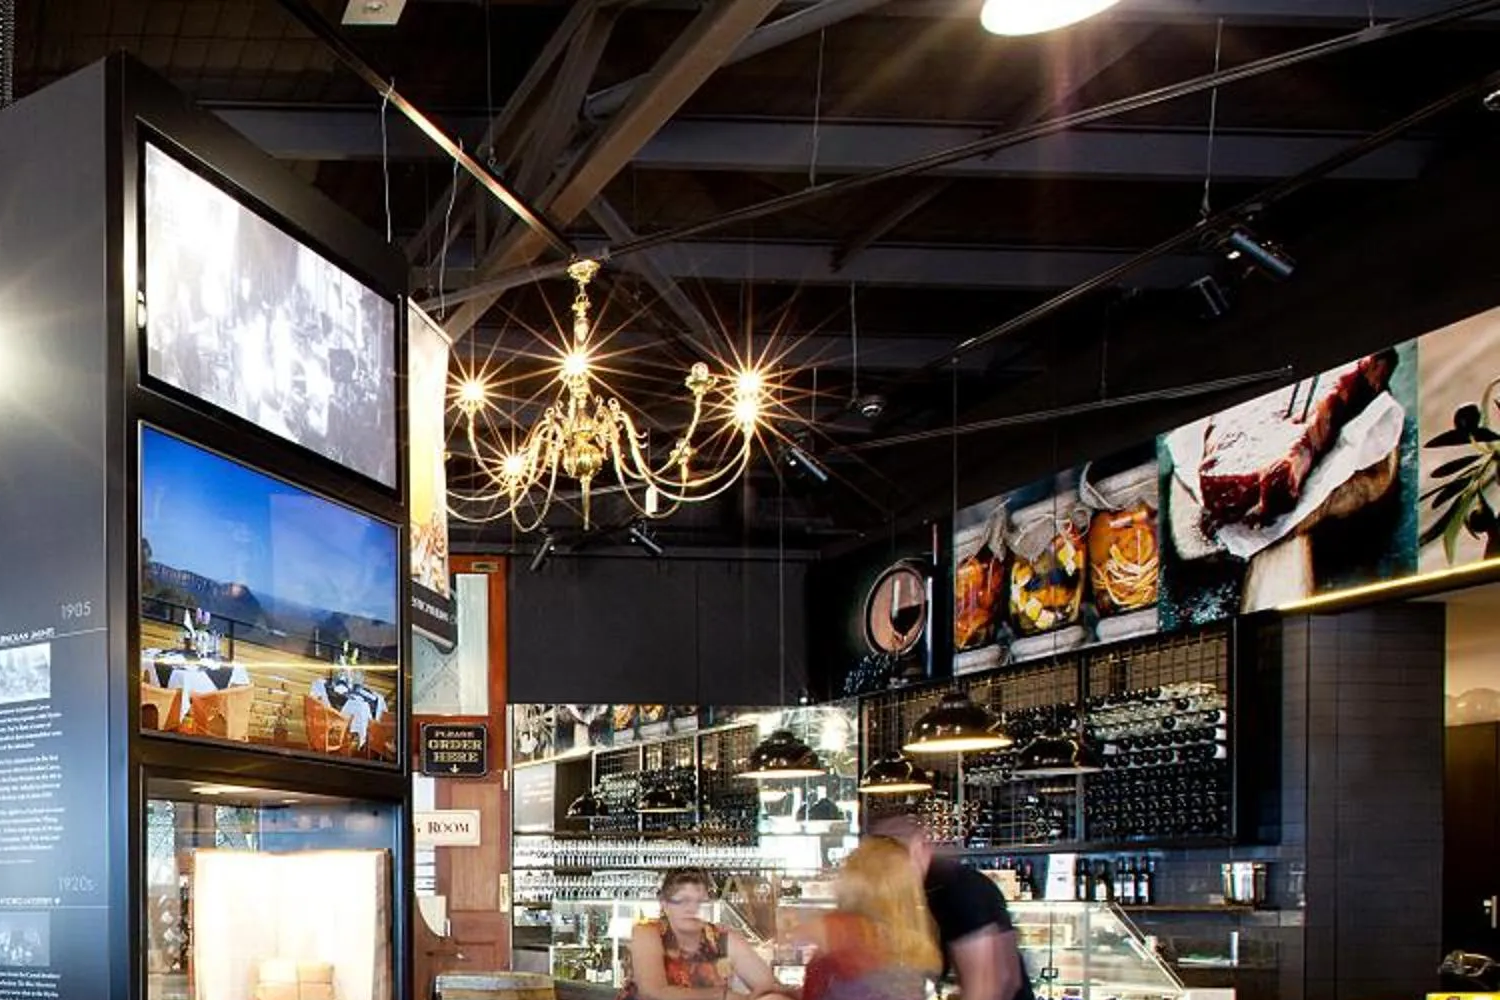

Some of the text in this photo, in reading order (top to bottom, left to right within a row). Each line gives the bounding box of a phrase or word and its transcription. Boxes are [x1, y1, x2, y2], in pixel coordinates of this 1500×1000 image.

[61, 601, 91, 620] 1905
[428, 739, 483, 750] ORDER
[434, 751, 479, 763] HERE
[428, 821, 469, 833] ROOM
